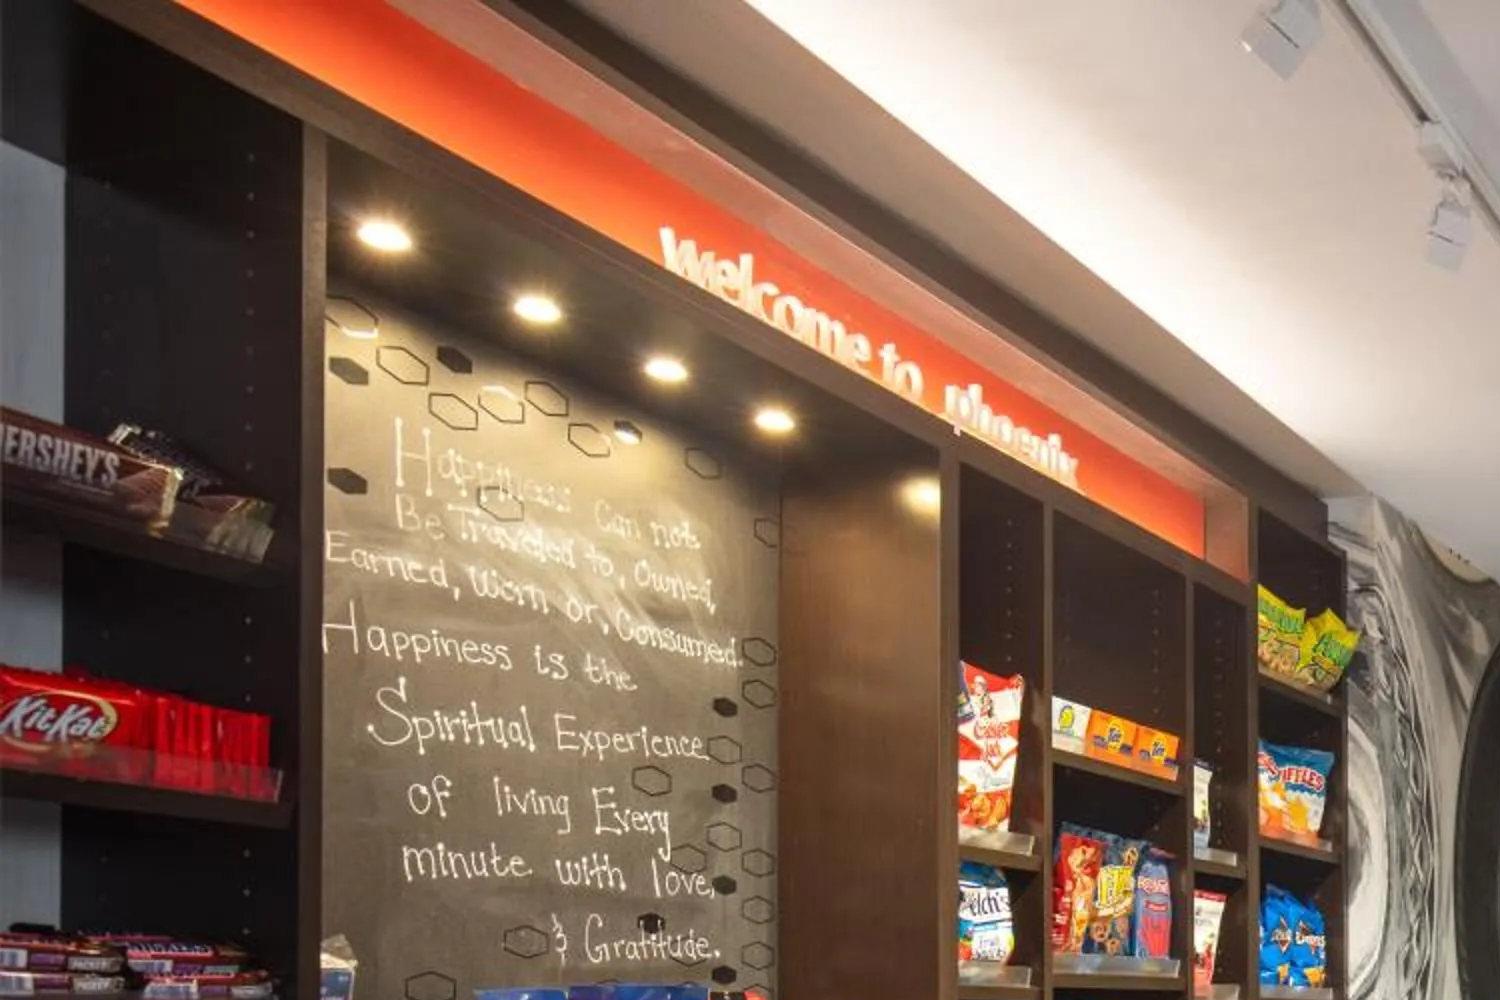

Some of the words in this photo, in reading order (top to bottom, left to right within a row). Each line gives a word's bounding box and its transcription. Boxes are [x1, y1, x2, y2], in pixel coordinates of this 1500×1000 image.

[659, 227, 871, 377] Welcome
[879, 342, 924, 400] to
[395, 417, 571, 512] Happiness
[594, 500, 641, 540] Can
[396, 494, 444, 541] Be
[325, 531, 461, 600] Earned,
[468, 566, 549, 614] Worn
[616, 610, 744, 668] Consumed.
[323, 600, 513, 670] Happiness
[535, 645, 569, 680] is
[585, 653, 638, 691] the
[367, 677, 537, 754] Spiritual
[555, 714, 709, 761] Experience
[494, 775, 571, 835] living
[592, 786, 671, 861] Every
[401, 841, 534, 883] minute
[555, 853, 626, 891] with
[584, 913, 721, 964] Gratitude.
